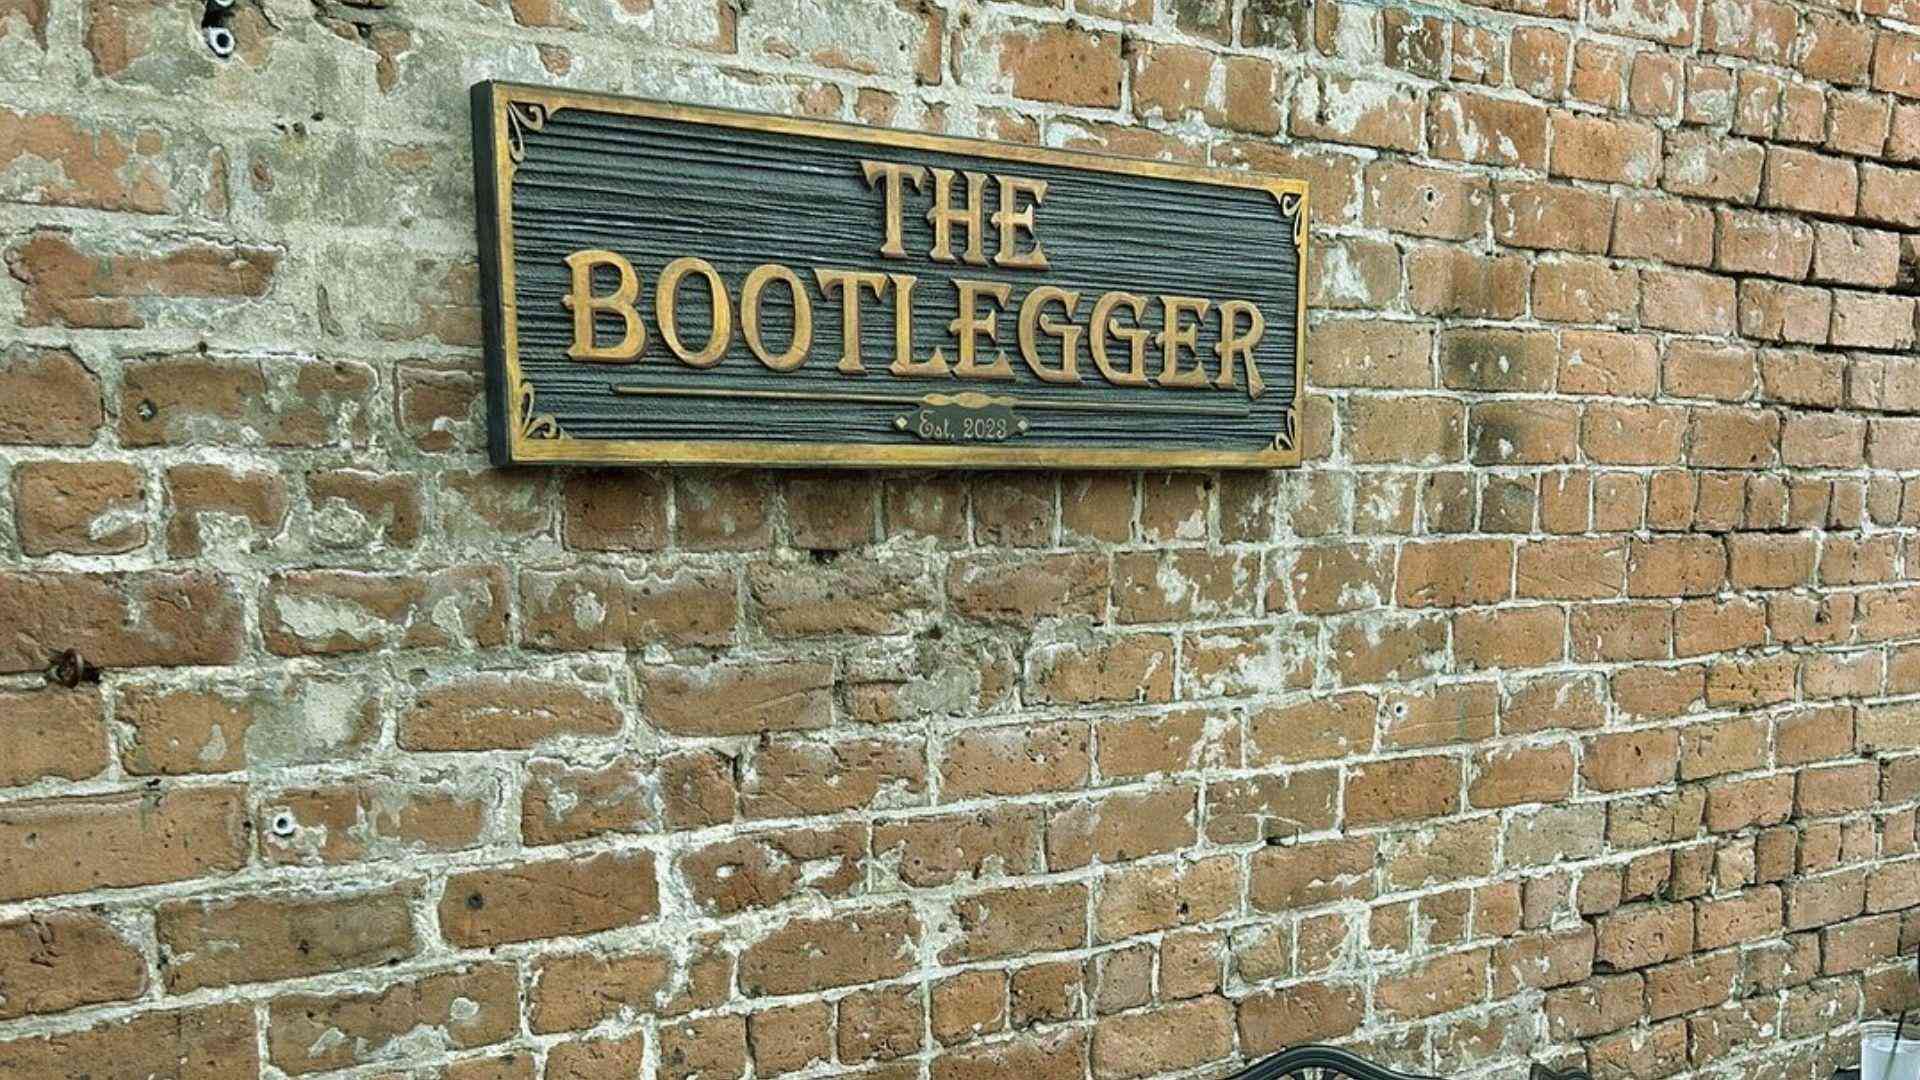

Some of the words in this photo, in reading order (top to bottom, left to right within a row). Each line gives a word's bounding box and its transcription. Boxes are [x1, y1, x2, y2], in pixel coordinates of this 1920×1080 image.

[860, 159, 1049, 270] THE
[562, 248, 1266, 398] BOOTLEGGER
[919, 410, 955, 438] Est.
[963, 417, 1007, 438] 2023
